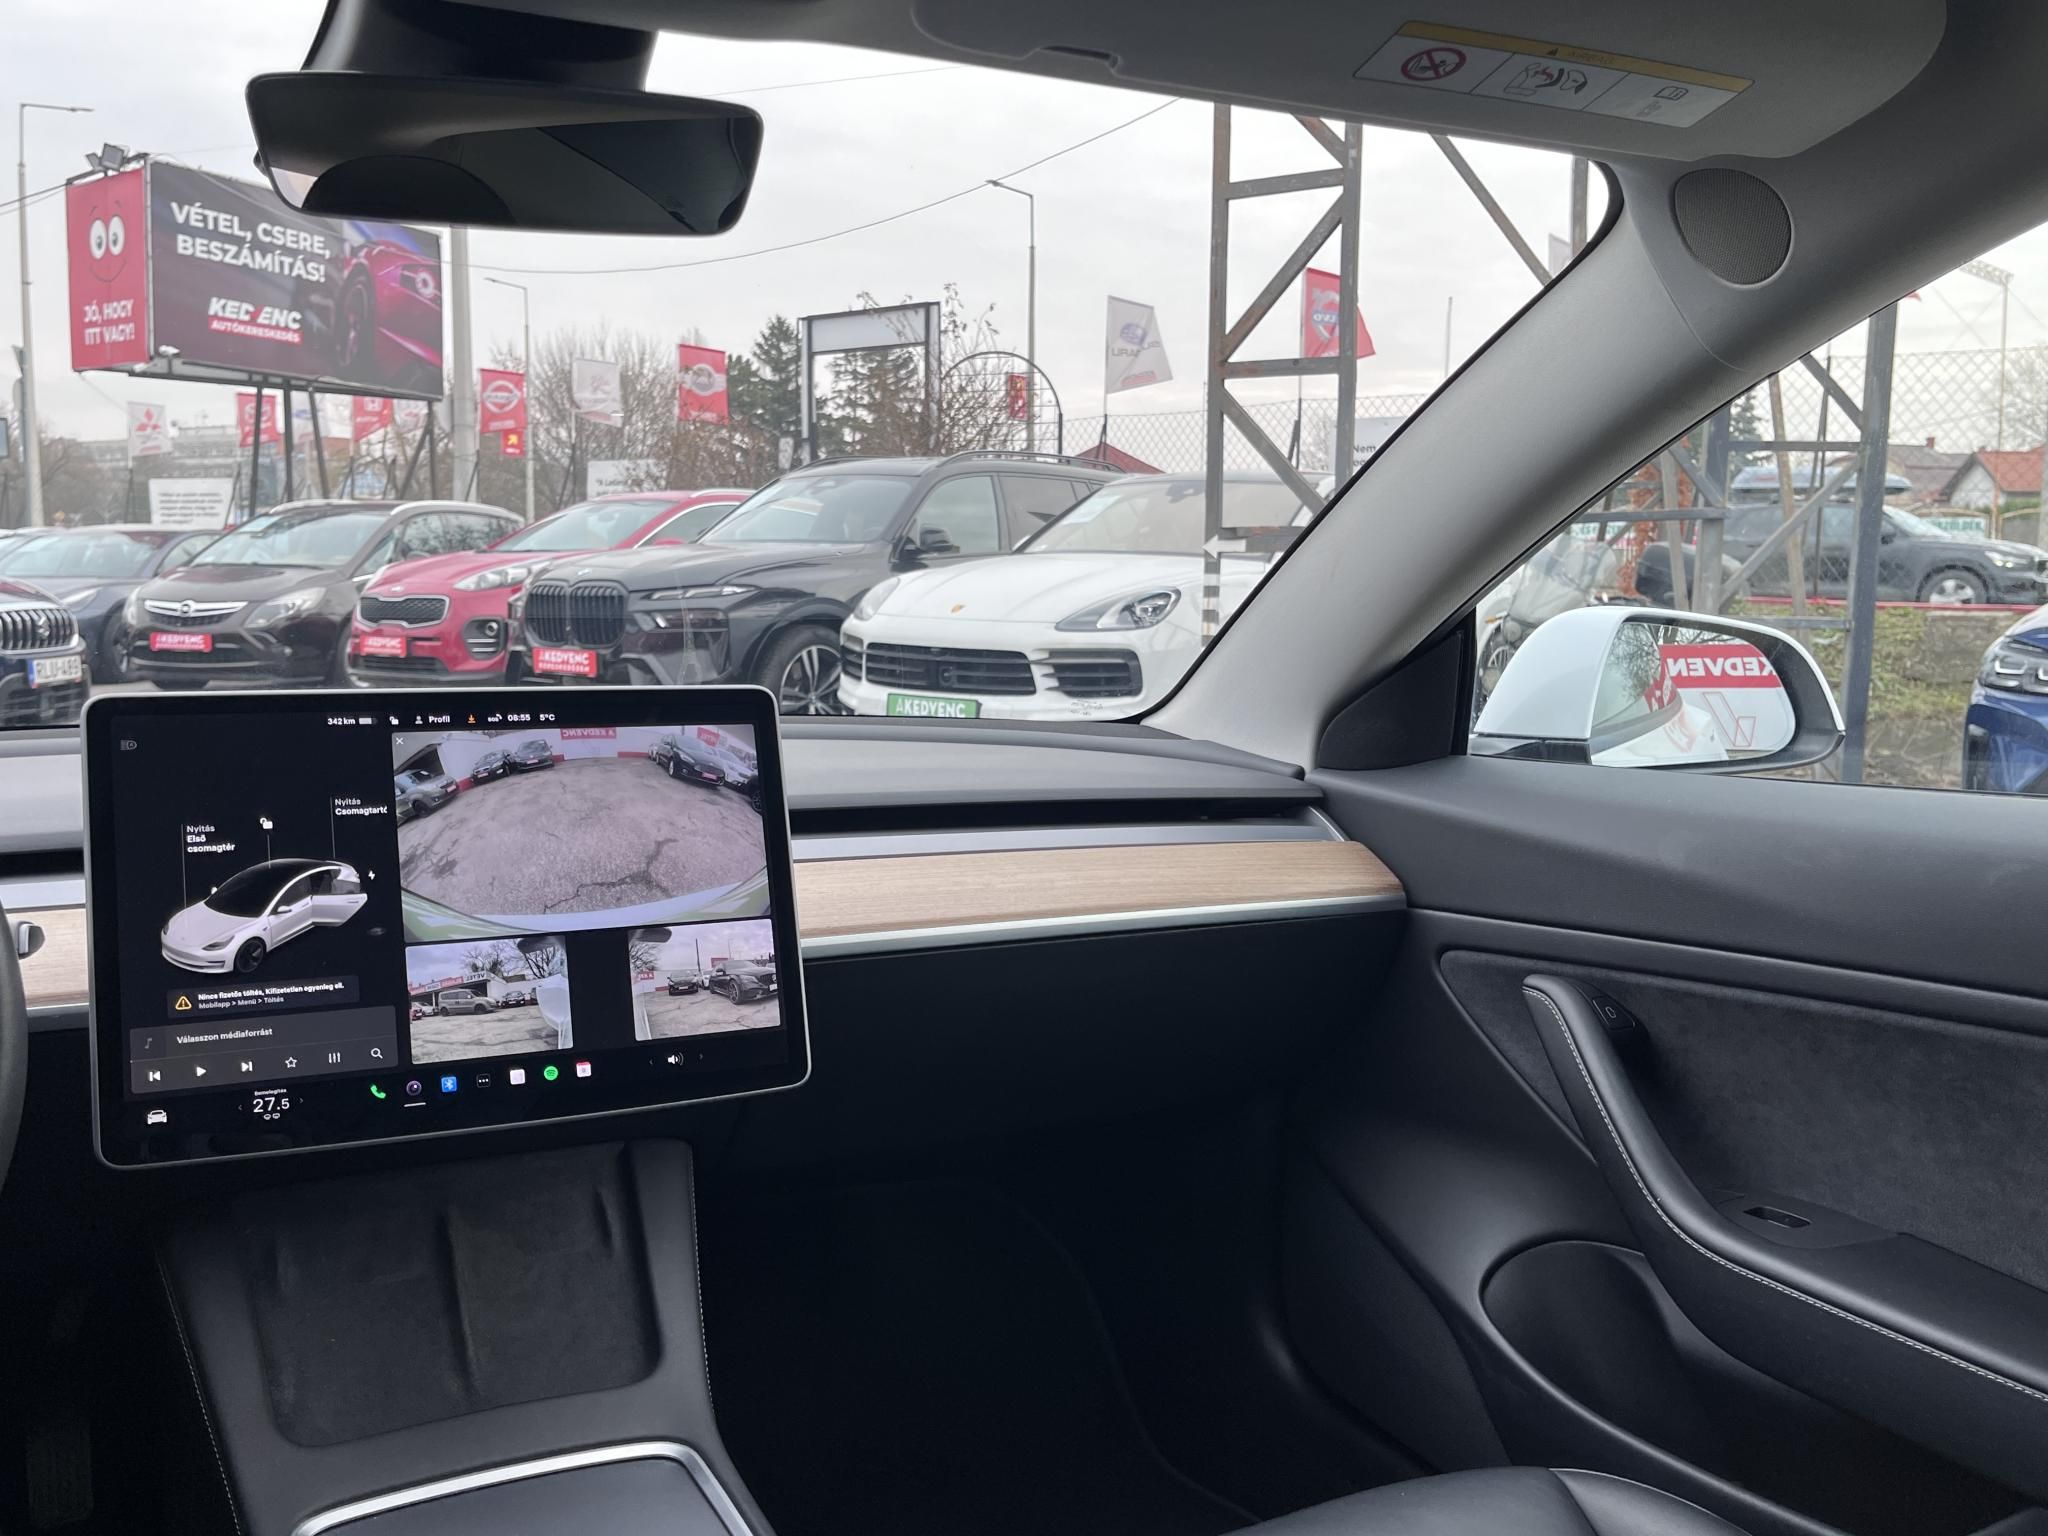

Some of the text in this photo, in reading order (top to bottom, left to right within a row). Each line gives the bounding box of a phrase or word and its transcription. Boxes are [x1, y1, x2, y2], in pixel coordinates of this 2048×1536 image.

[170, 202, 331, 260] VÉTEL, CSERE,
[176, 233, 326, 283] BESZÁMÍTÁS!
[84, 298, 134, 325] JÓ, HOGY
[84, 322, 136, 346] ITT VAGY!
[327, 717, 356, 727] 342 km
[428, 715, 450, 724] Profil
[507, 713, 531, 723] 08:55
[540, 713, 556, 722] 5°C
[335, 798, 361, 807] Nyitás
[186, 825, 215, 833] Nyitás
[187, 834, 206, 843] Első
[187, 843, 236, 853] csomagtér
[199, 1000, 231, 1009] Mobilapp
[237, 998, 257, 1006] Menü
[176, 1027, 273, 1044] Válasszon médiaforrást
[252, 1096, 290, 1113] 27.5
